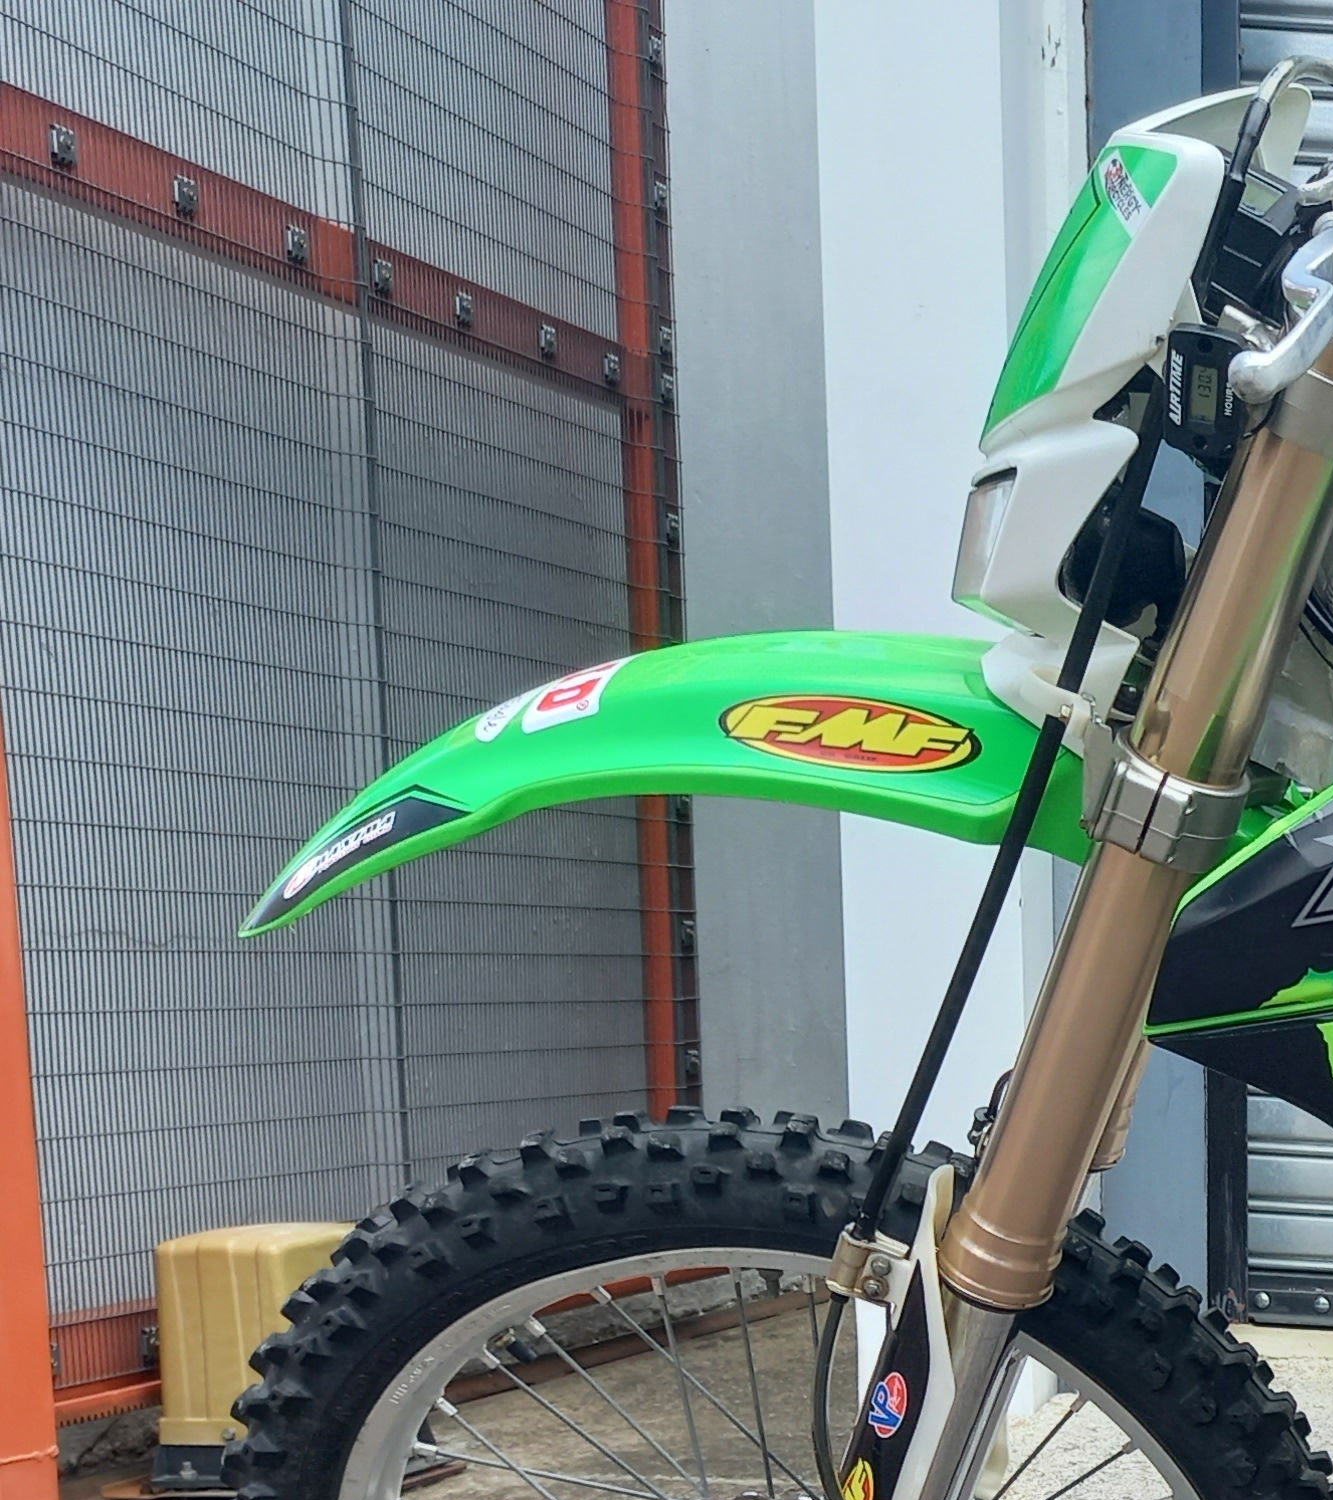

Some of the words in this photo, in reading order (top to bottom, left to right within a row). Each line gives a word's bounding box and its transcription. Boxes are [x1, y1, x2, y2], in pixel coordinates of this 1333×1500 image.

[1168, 348, 1184, 427] AIRTIME
[728, 704, 972, 758] FMF
[868, 1380, 901, 1430] VP
